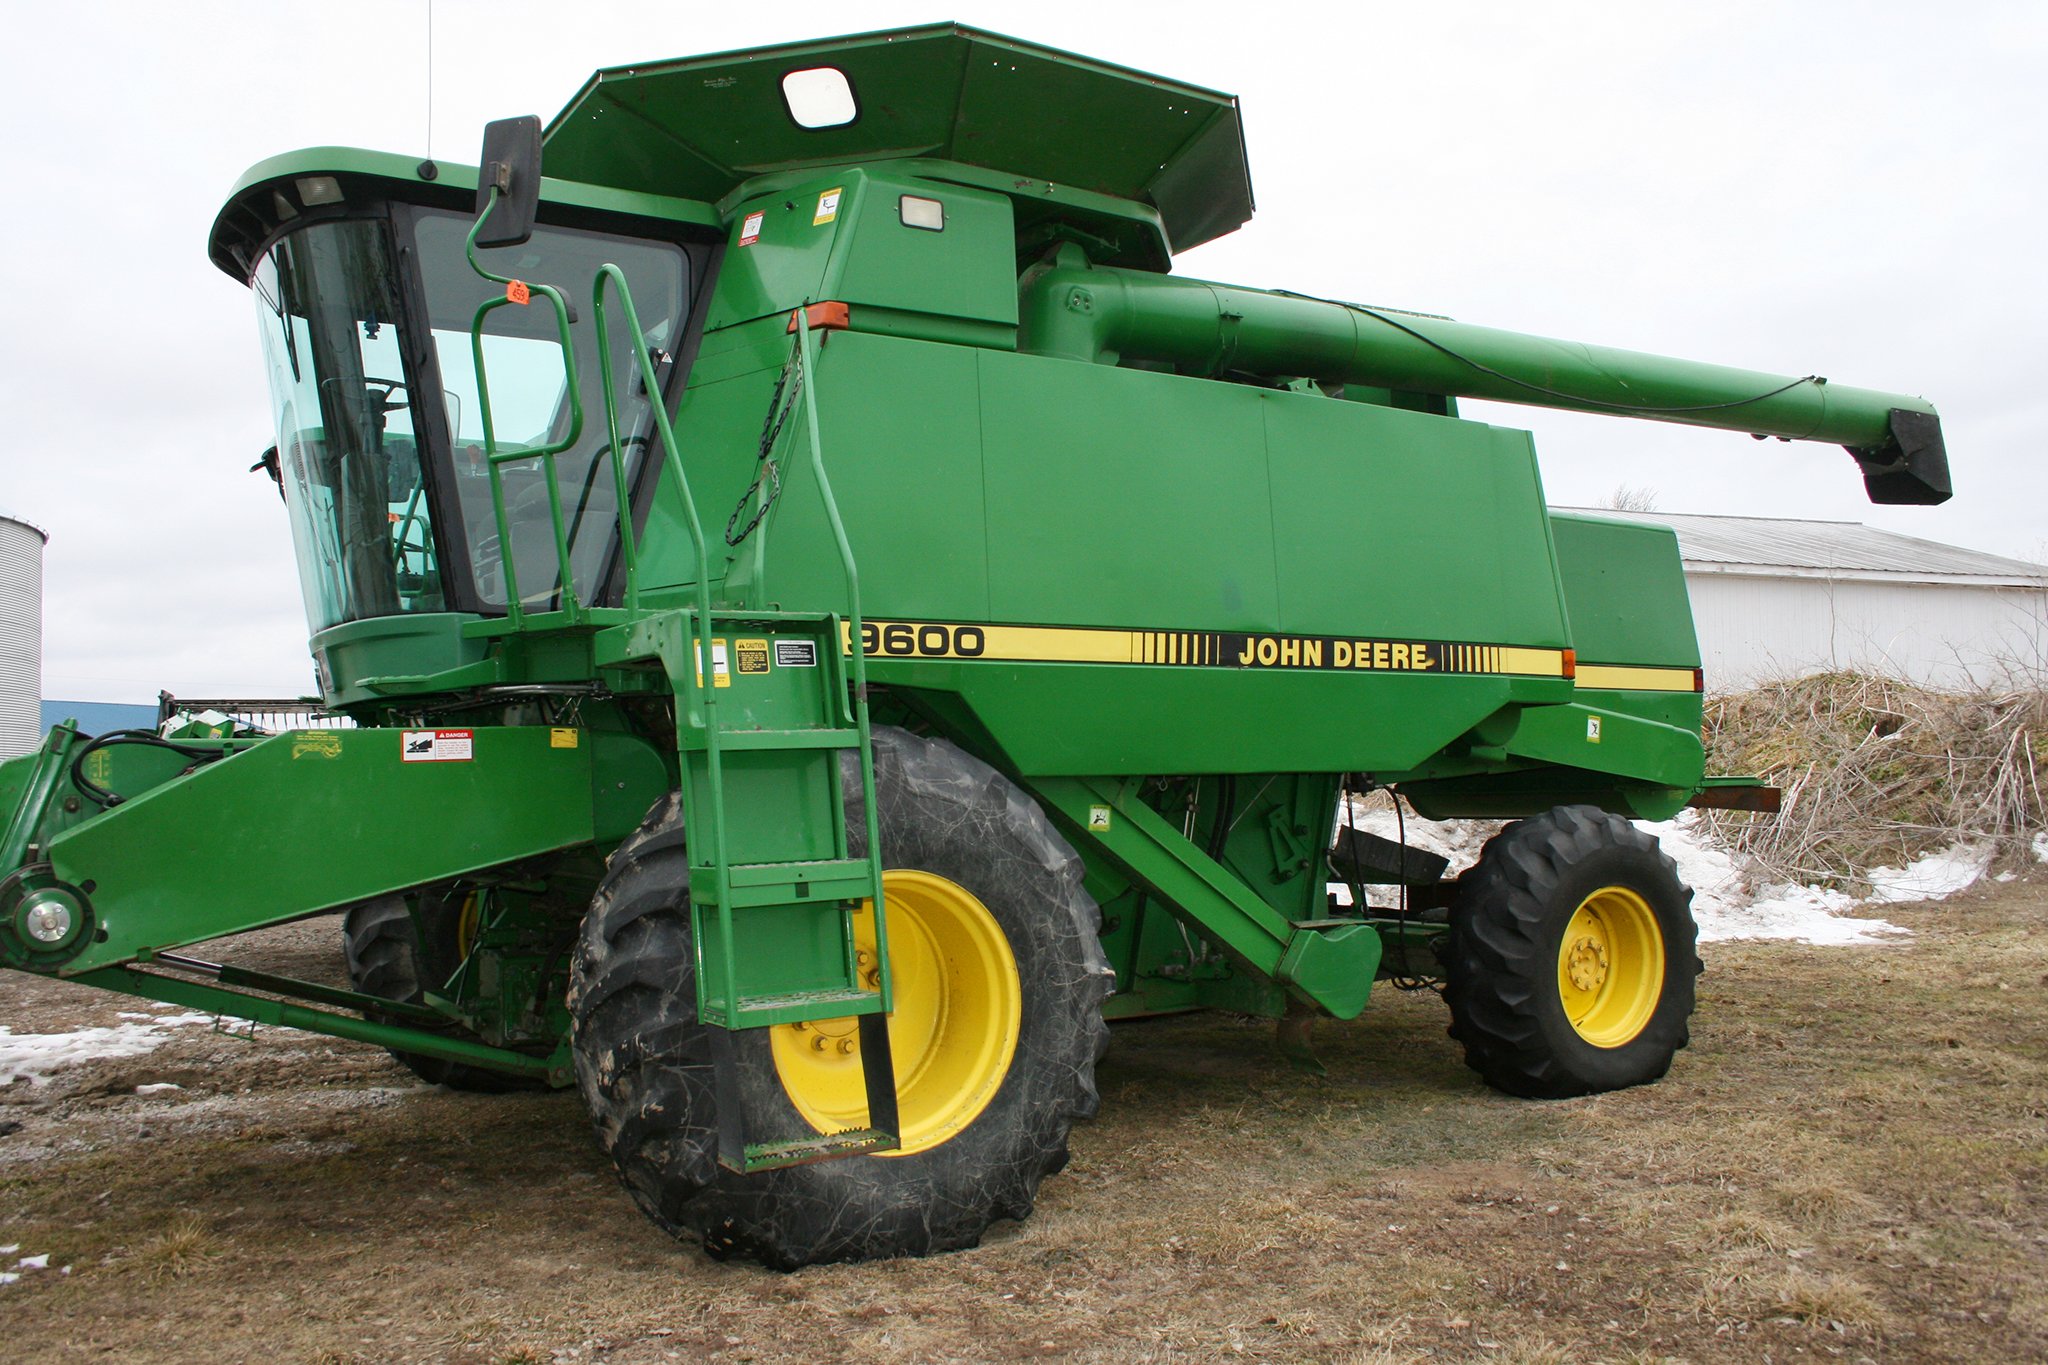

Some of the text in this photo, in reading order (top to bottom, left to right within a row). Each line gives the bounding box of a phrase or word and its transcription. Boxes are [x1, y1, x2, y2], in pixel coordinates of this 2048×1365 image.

[847, 623, 985, 656] 9600
[1238, 637, 1427, 670] JOHN DEERE
